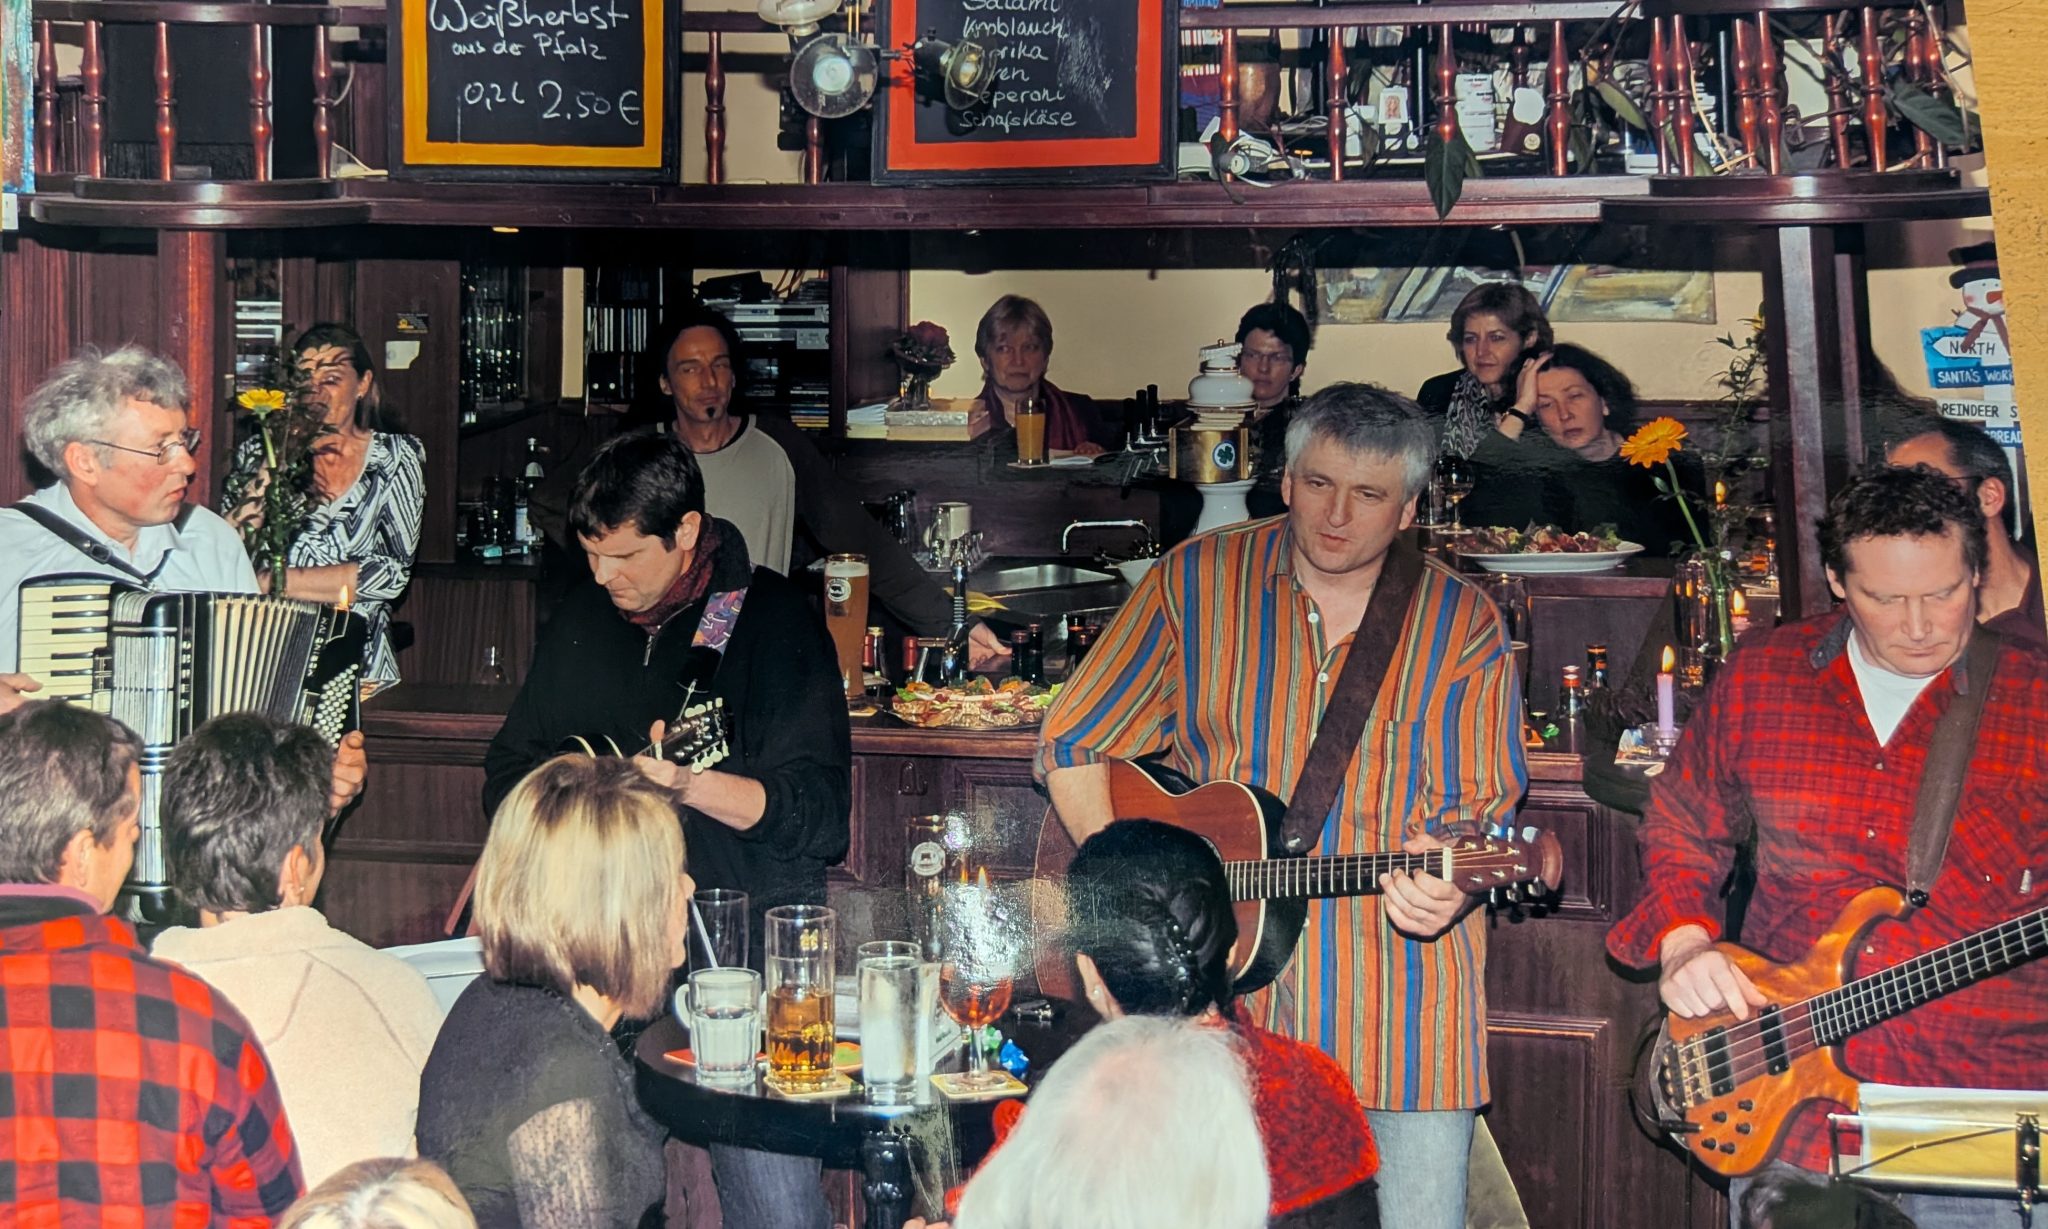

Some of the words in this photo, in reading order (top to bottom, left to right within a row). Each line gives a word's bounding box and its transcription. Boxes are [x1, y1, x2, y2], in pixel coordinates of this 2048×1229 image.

[452, 41, 486, 56] aus
[493, 40, 526, 56] der
[533, 31, 607, 62] Pfalz
[981, 83, 1066, 108] eperoni
[1949, 340, 1996, 356] NRTH
[1937, 369, 1981, 384] SANTA'S
[1941, 403, 2000, 418] REINDEER
